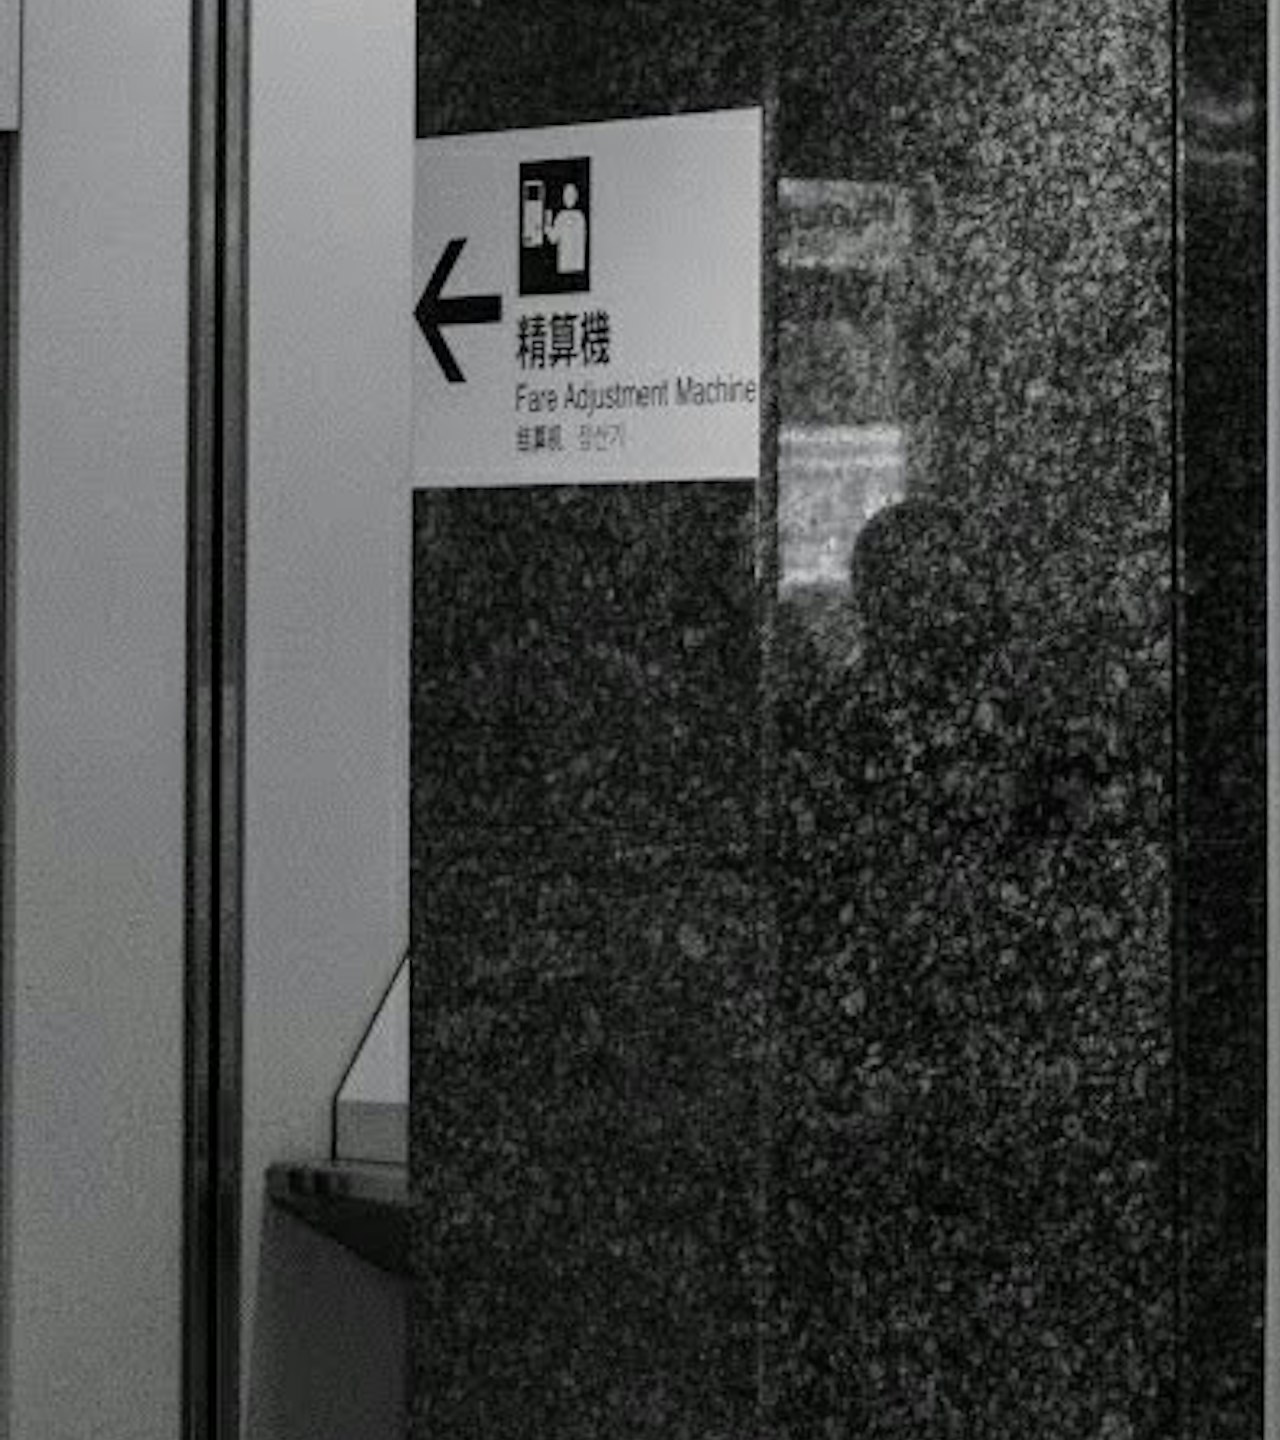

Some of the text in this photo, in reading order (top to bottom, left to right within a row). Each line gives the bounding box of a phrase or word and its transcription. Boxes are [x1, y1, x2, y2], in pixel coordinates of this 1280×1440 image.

[516, 310, 611, 370] 精算機
[515, 374, 757, 419] Fare Adjustment Machine
